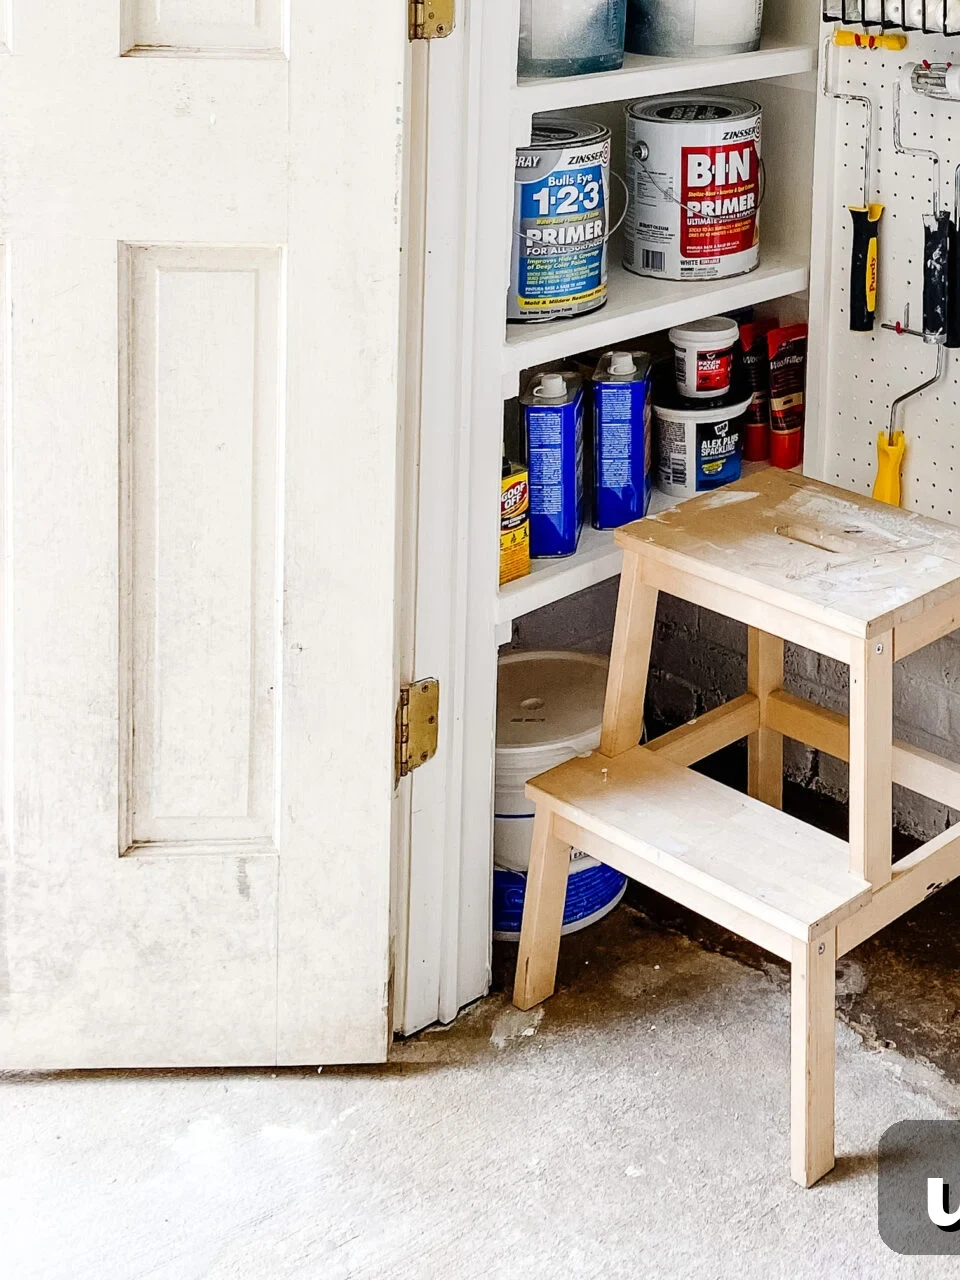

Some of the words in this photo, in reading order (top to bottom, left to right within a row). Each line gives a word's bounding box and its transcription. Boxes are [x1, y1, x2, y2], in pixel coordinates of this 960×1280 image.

[722, 126, 756, 140] ZINSSER
[568, 151, 604, 165] ZINSSER
[548, 174, 575, 186] Bulls
[577, 173, 593, 185] Eye
[686, 192, 756, 217] PRIMER
[687, 218, 718, 226] ULTIMATE
[526, 219, 603, 247] PRIMER
[526, 247, 547, 255] FOR
[550, 246, 567, 254] ALL
[527, 257, 557, 265] Improves
[554, 261, 569, 269] Color
[549, 297, 570, 305] Mildew
[716, 422, 728, 433] DAP
[701, 438, 722, 449] ALEX
[723, 433, 739, 445] PLUS
[701, 444, 735, 456] SPACKLING
[501, 481, 526, 502] GOOF
[504, 492, 522, 509] OFF
